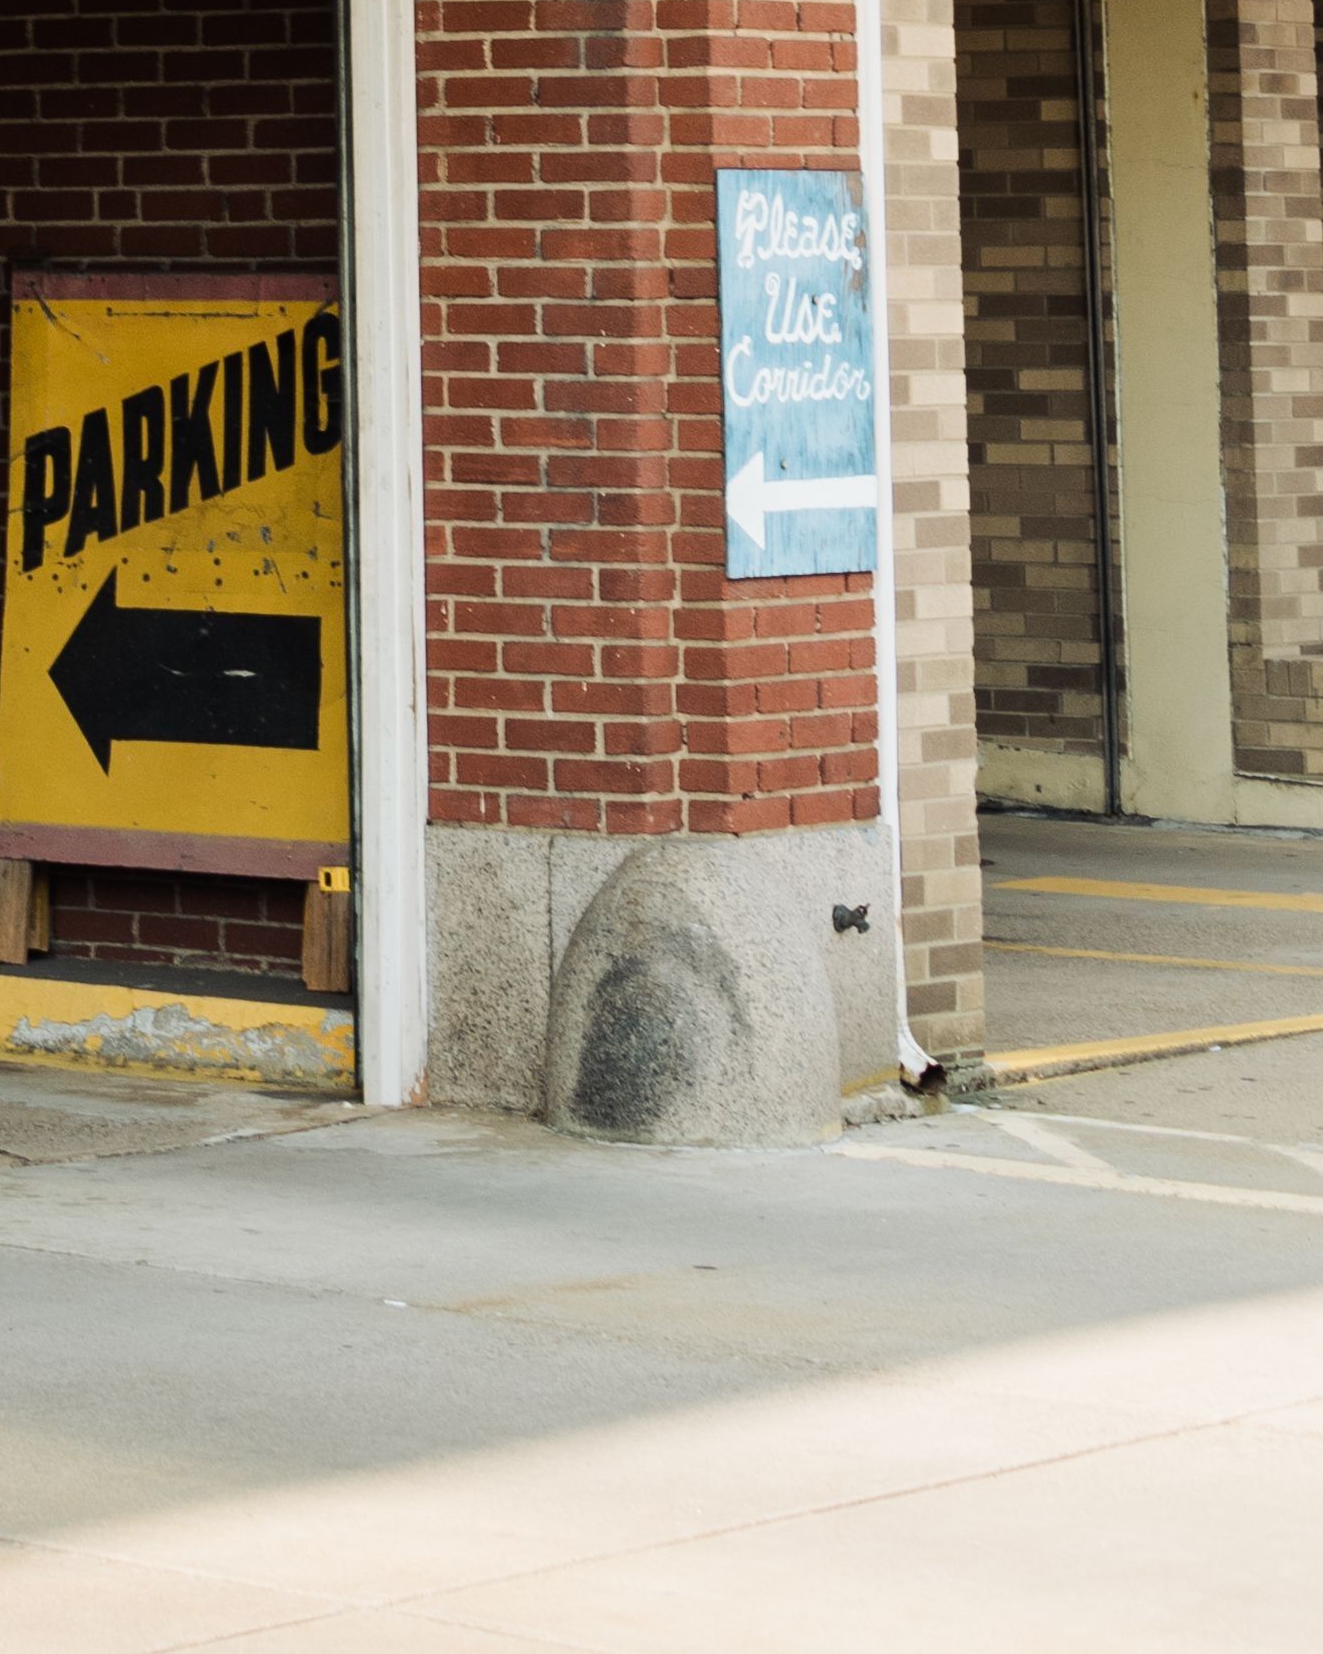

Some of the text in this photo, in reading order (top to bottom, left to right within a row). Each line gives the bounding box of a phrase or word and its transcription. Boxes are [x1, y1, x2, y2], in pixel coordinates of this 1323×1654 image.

[734, 188, 863, 269] Please
[764, 272, 842, 345] Use
[726, 335, 871, 408] Corridor
[22, 311, 342, 575] PARKING
